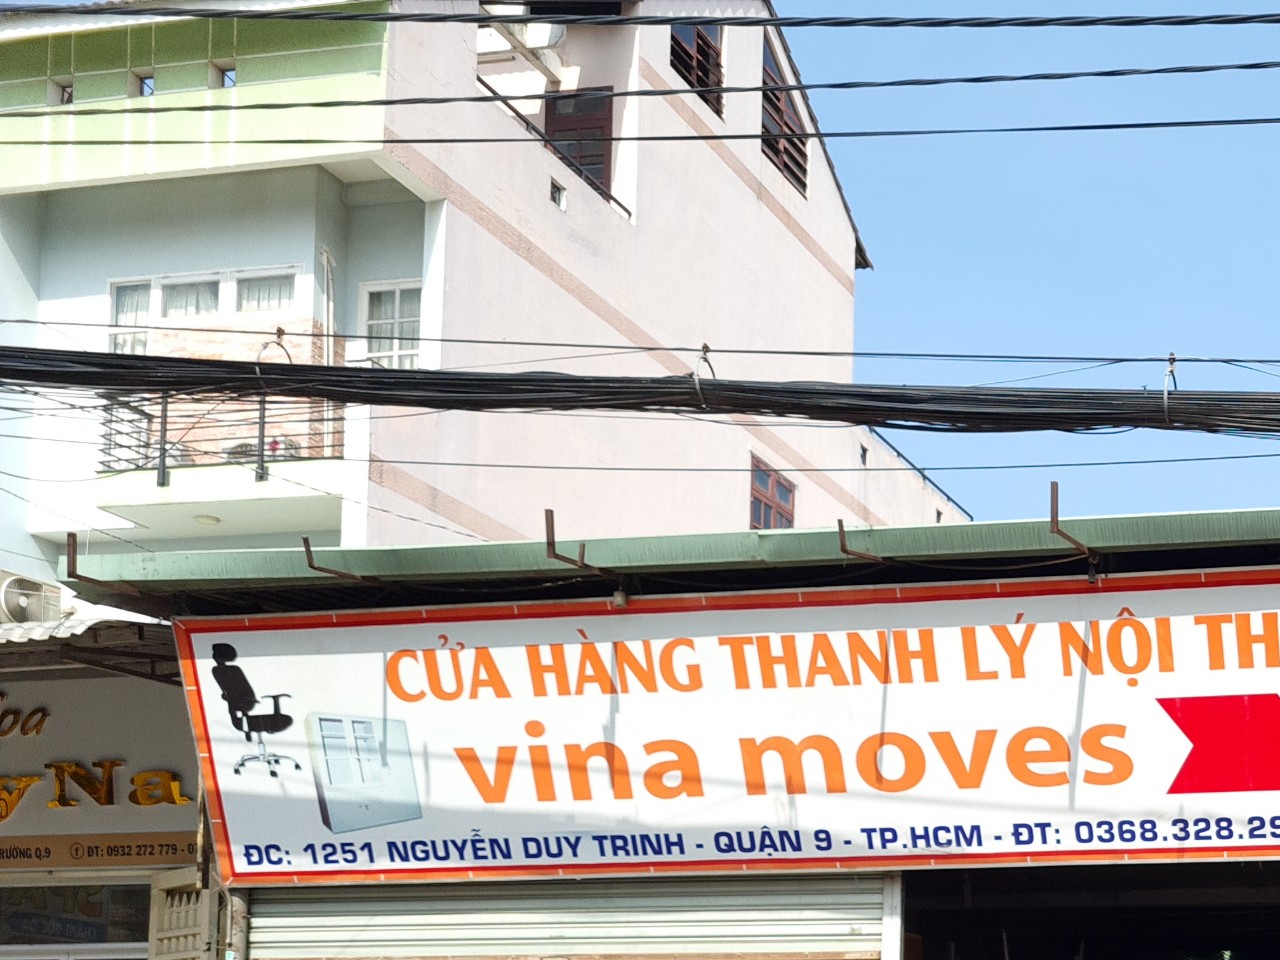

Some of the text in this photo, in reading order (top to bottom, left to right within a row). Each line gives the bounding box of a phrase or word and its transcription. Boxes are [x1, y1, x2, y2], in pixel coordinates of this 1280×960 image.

[386, 633, 512, 703] CỬA
[526, 629, 703, 697] HÀNG
[718, 628, 939, 689] THANH
[961, 613, 1036, 681] LÝ
[1060, 606, 1175, 687] NỘI
[454, 720, 1134, 804] vina moves
[107, 845, 132, 857] 0932
[136, 844, 155, 856] 272
[158, 844, 178, 855] 779
[243, 843, 292, 867] ĐC:
[303, 841, 375, 865] 1251
[387, 828, 513, 863] NGUYỄN
[522, 835, 582, 859] DUY
[592, 833, 686, 857] TRINH
[713, 824, 803, 856] QUẬN
[814, 829, 833, 852] 9
[860, 824, 982, 850] TP.HCM
[1011, 822, 1061, 846] ĐT:
